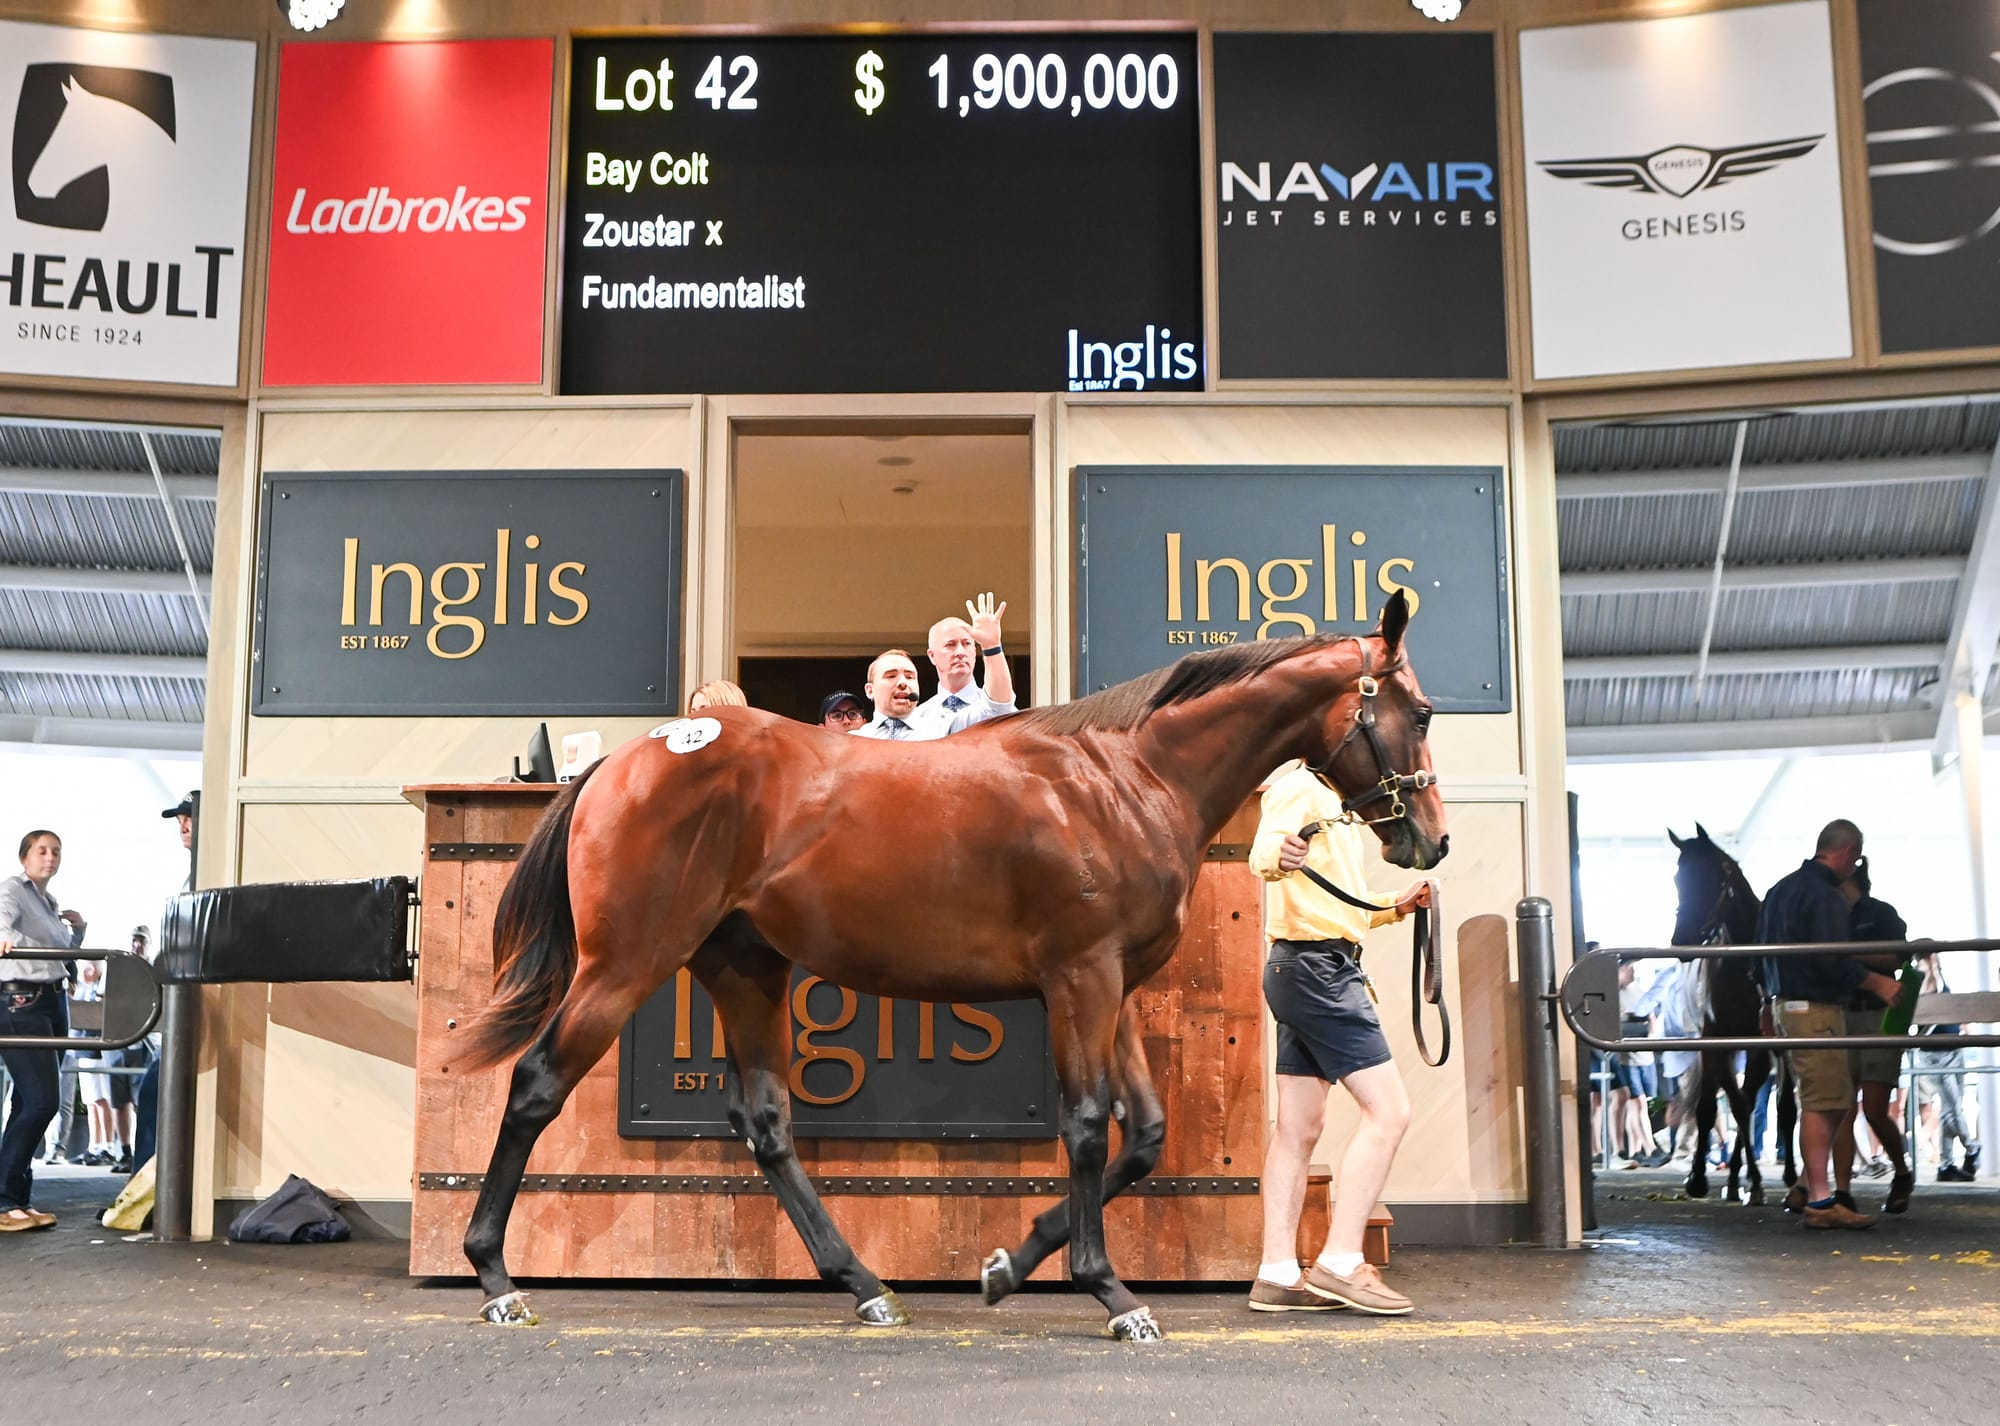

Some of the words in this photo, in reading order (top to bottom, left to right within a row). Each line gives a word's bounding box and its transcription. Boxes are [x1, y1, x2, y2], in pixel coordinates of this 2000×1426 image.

[595, 56, 675, 112] Lot
[694, 55, 759, 110] 42
[854, 49, 885, 116] $
[928, 53, 1179, 118] 1,900,000
[586, 151, 643, 193] Bay
[649, 151, 710, 186] Colt
[1221, 161, 1495, 202] NAVAIR
[286, 186, 532, 234] Ladbrokes
[1223, 210, 1283, 226] JET
[1313, 210, 1497, 226] SERVICES
[1620, 210, 1746, 241] GENESIS
[582, 212, 696, 248] Zoustar
[704, 220, 725, 247] x
[582, 275, 806, 310] Fundamentalist
[17, 322, 81, 342] SINCE
[94, 327, 143, 345] 1924
[1068, 324, 1197, 390] Inglis
[341, 528, 590, 660] Inglis
[341, 635, 367, 649] EST
[373, 635, 410, 649] 1867
[1168, 631, 1195, 644] EST
[1200, 631, 1238, 644] 1867
[673, 1072, 709, 1090] EST
